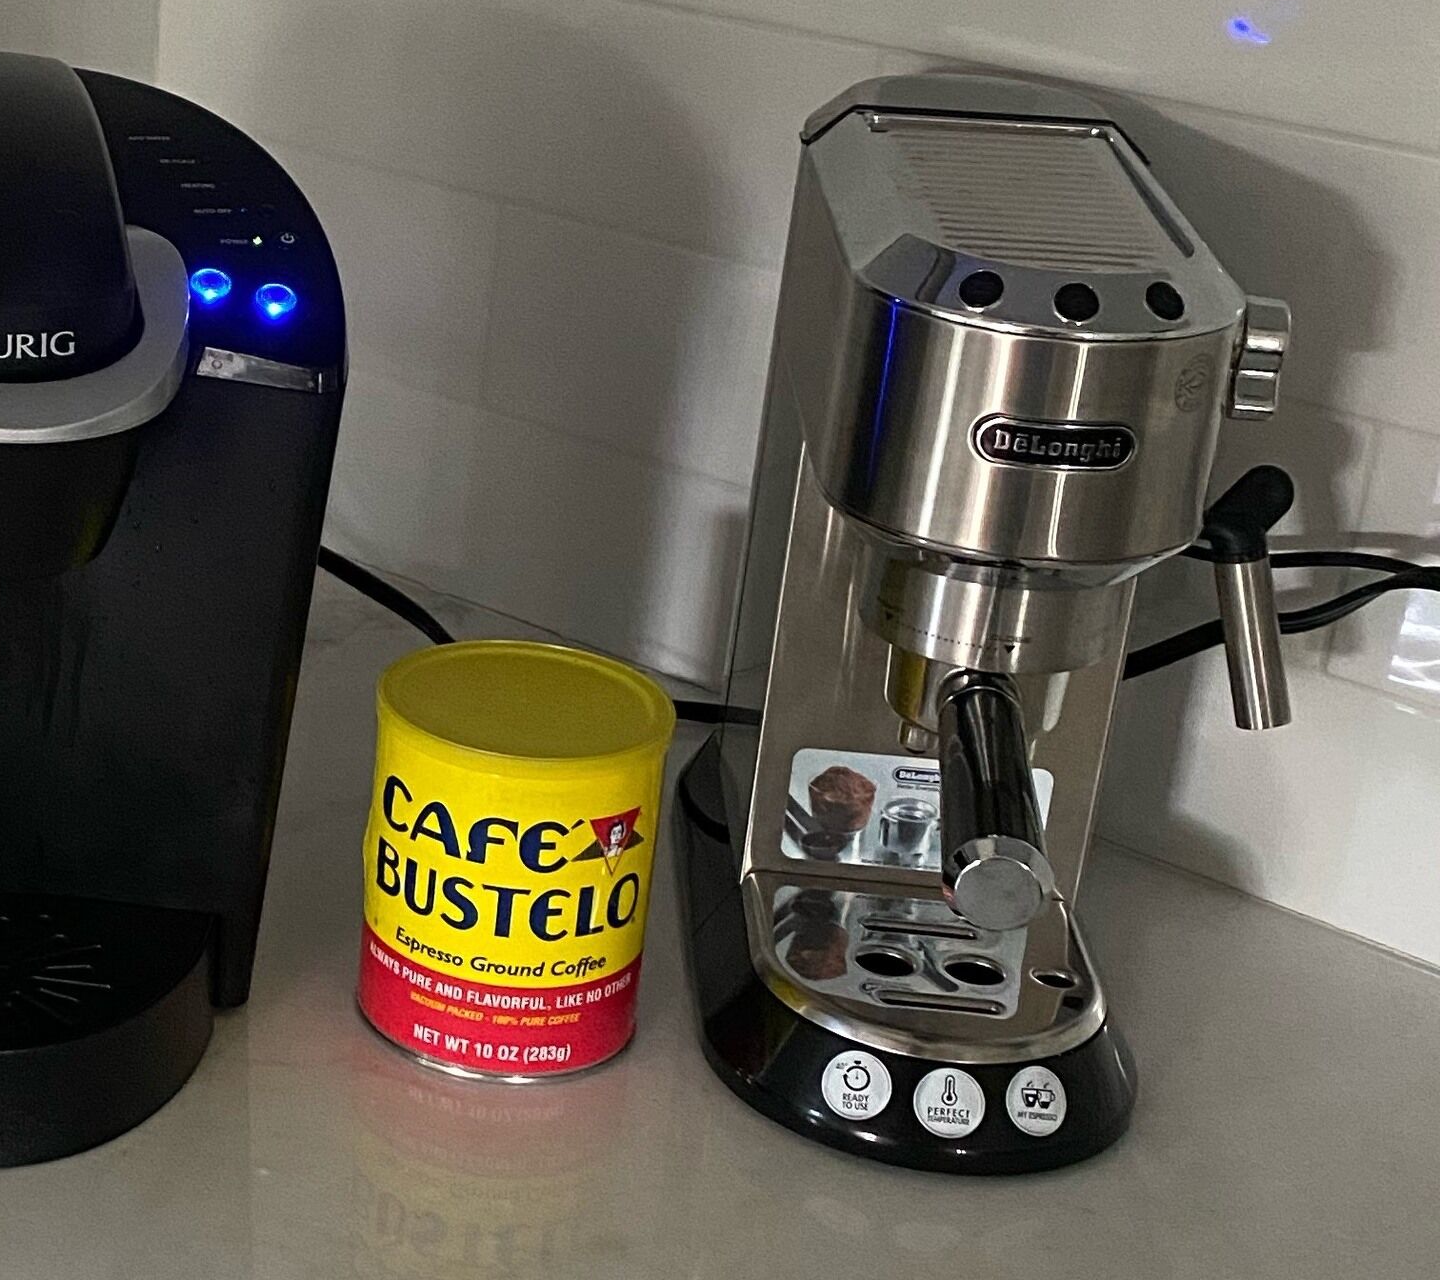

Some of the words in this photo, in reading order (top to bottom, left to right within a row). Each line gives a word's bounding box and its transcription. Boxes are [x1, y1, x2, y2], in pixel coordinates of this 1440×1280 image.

[383, 775, 584, 873] CAFÉ
[375, 835, 640, 942] BUSTELO
[396, 926, 463, 966] Espresso
[470, 956, 545, 977] Ground
[551, 955, 607, 978] Coffee
[369, 940, 401, 975] ALWAYS
[401, 966, 433, 992] PURE
[435, 981, 462, 1001] AND
[466, 989, 551, 1011] FLAVORFUL,
[555, 992, 584, 1010] LIKE
[585, 987, 602, 1005] NO
[604, 972, 632, 998] OTHER
[446, 1005, 484, 1021] PACKED
[520, 1016, 546, 1026] PURE
[413, 1023, 440, 1047] NET
[444, 1034, 469, 1055] WT
[474, 1043, 493, 1060] 10
[497, 1045, 520, 1062] OZ
[523, 1042, 572, 1065] (283g)
[842, 1093, 870, 1102] READY
[843, 1101, 853, 1109] TO
[854, 1102, 868, 1110] USE
[927, 1106, 970, 1119] PERFECT
[1017, 1111, 1027, 1119] MY
